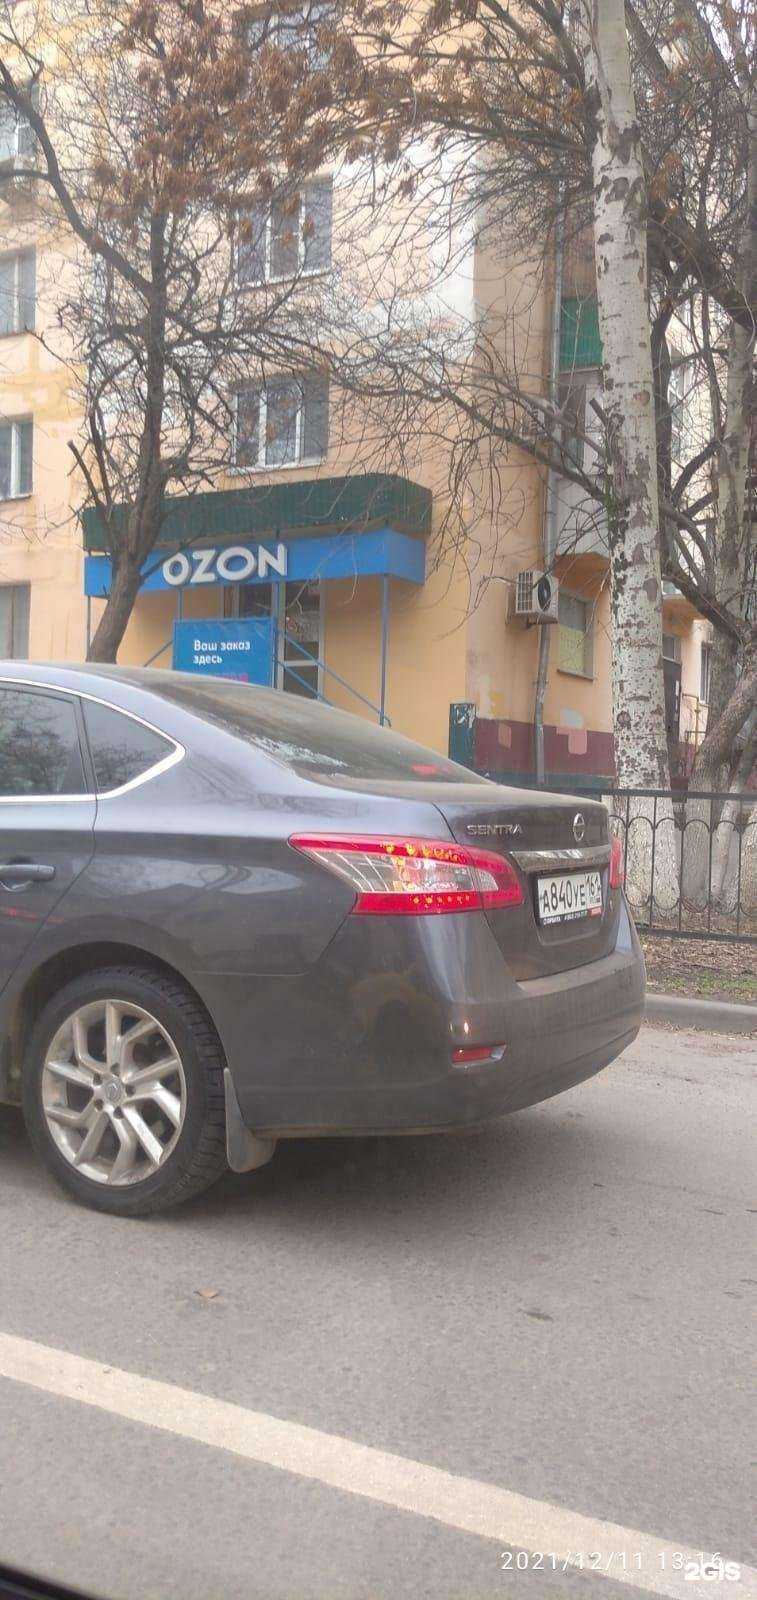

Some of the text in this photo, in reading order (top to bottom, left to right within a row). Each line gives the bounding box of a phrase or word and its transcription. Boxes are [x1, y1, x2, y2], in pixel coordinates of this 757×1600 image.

[163, 543, 287, 585] OZON
[193, 640, 250, 651] Ваш заказ
[193, 654, 222, 665] здесь
[466, 824, 522, 835] SENTRA
